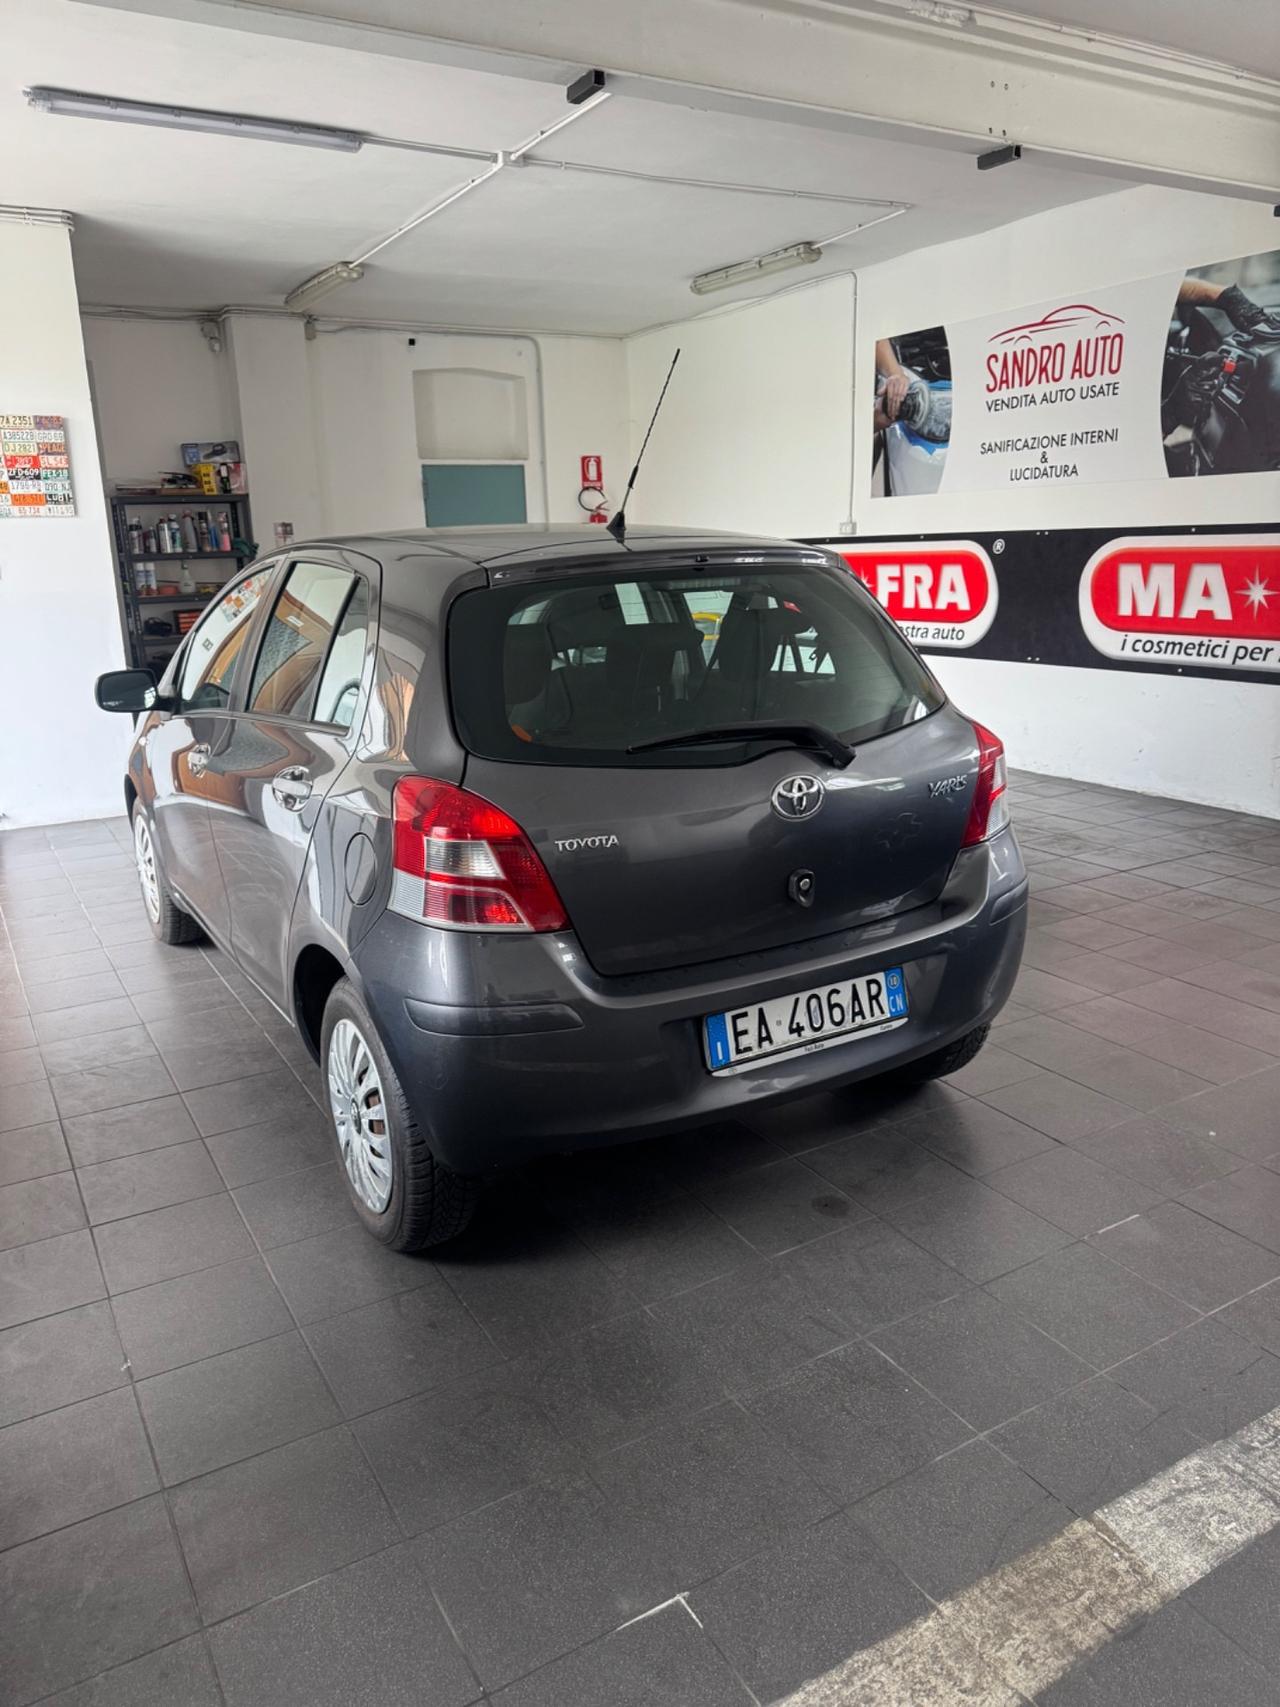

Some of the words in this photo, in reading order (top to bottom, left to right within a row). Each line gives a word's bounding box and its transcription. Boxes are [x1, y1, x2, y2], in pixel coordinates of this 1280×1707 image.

[986, 341, 1065, 393] SANDRO
[1070, 332, 1124, 380] AUTO
[986, 393, 1038, 413] VENDITA
[1039, 388, 1078, 405] AUTO
[1079, 381, 1120, 400] USATE
[980, 434, 1067, 455] SANIFICAZIONE
[1069, 428, 1119, 446] INTERNI
[1040, 451, 1049, 463] &
[1009, 463, 1079, 482] LUCIDATURA
[876, 563, 971, 611] FRA
[1117, 563, 1234, 622] MA
[932, 626, 966, 641] auto
[1120, 633, 1128, 652] i
[1130, 637, 1230, 659] cosmetici
[1232, 645, 1274, 666] per
[928, 774, 968, 799] YARIS
[554, 834, 620, 853] TOYOTA
[731, 1007, 774, 1055] EA
[788, 978, 886, 1038] 406AR
[888, 993, 905, 1013] CN
